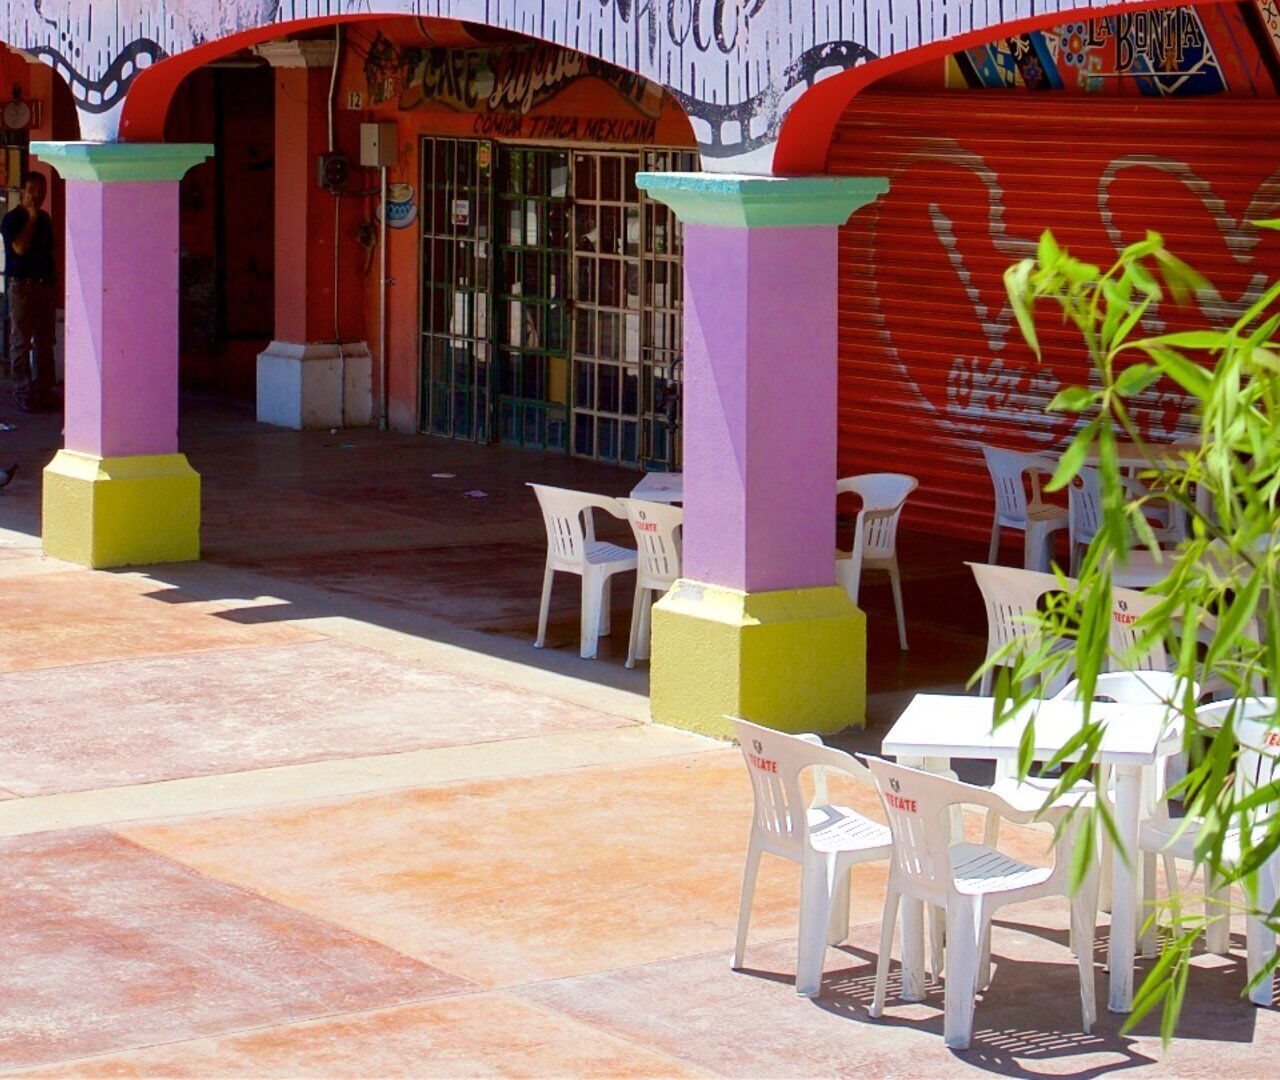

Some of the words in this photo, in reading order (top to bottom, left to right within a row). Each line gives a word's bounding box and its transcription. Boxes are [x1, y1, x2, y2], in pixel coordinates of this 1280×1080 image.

[473, 115, 522, 135] COMIDA
[583, 118, 658, 144] MEXICANA
[1113, 611, 1139, 625] TECAT
[748, 753, 778, 773] TECATE
[885, 792, 918, 813] TECATE
